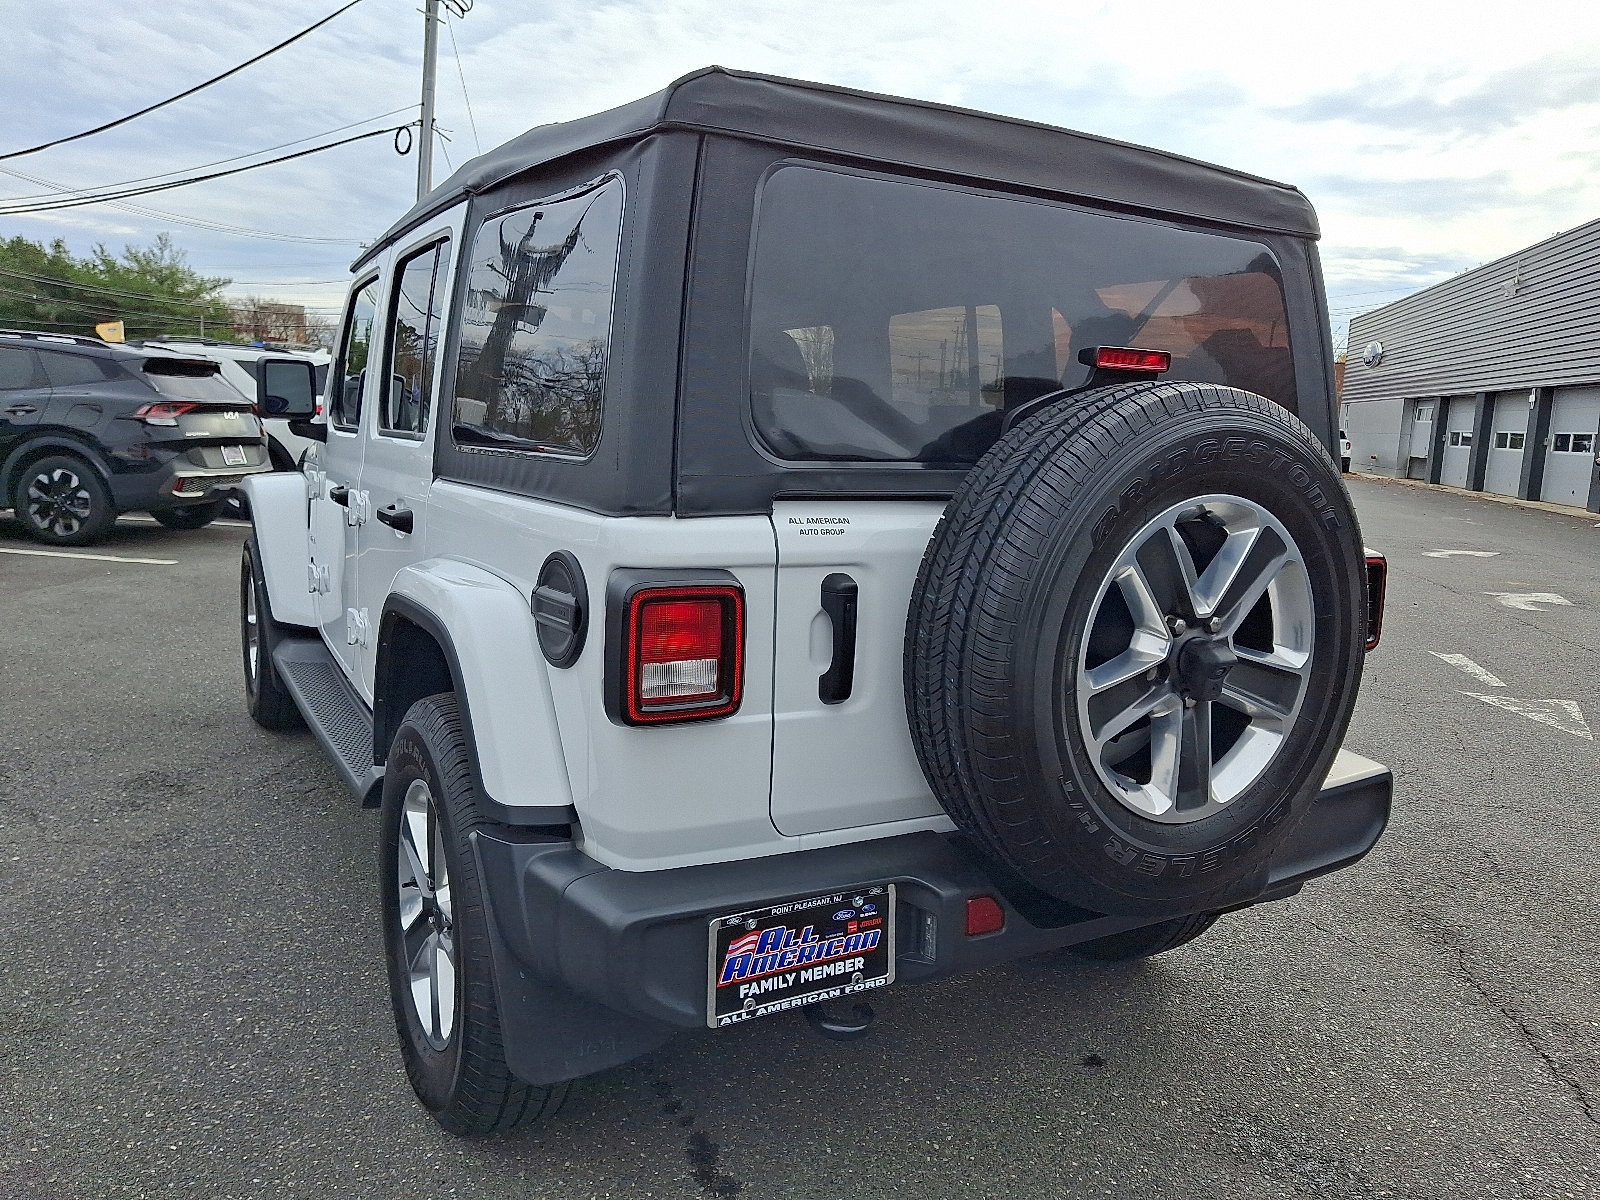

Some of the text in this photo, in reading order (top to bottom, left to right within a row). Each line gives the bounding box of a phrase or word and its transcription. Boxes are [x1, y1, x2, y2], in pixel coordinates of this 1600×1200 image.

[799, 528, 845, 536] AUTO GROUP
[806, 517, 851, 525] AMERICAN
[771, 894, 844, 916] POINT PLEASANT, NJ
[739, 957, 865, 999] FAMILY MEMBER
[719, 978, 887, 1026] ALL AMERICAN FORD
